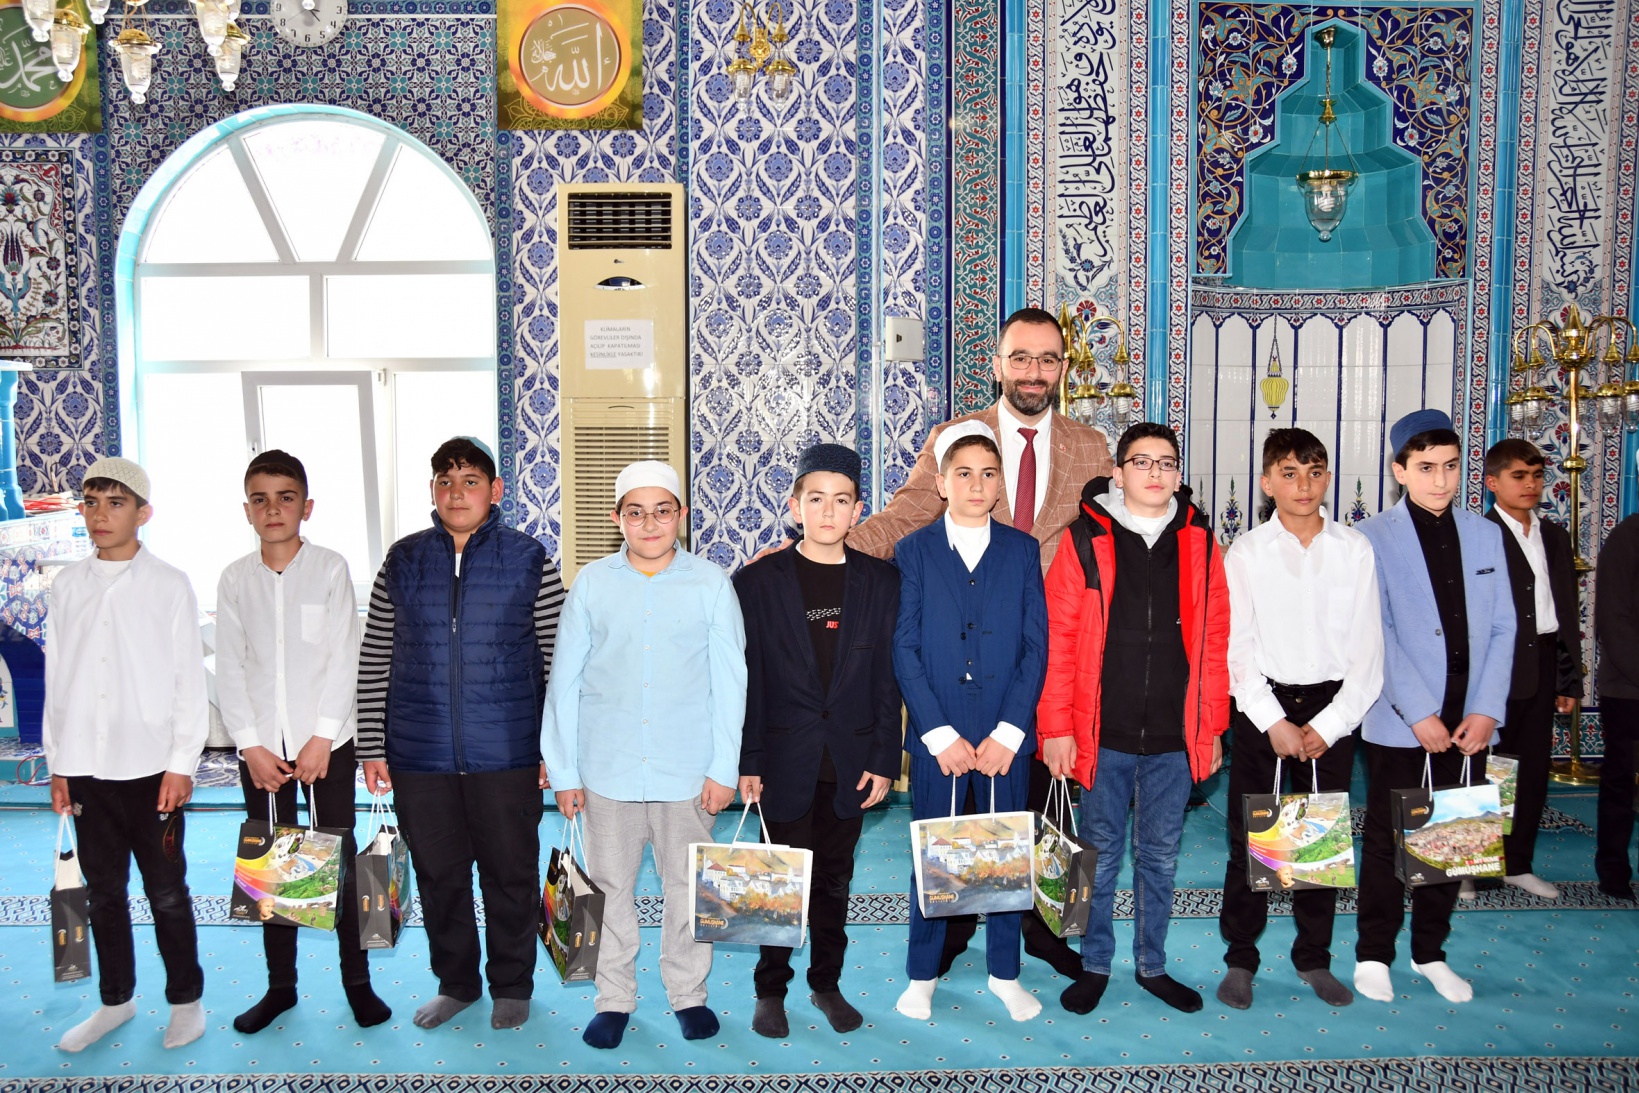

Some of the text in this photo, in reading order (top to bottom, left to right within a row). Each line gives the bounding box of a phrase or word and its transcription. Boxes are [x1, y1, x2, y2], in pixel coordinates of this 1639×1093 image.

[276, 3, 282, 12] 9
[336, 6, 342, 14] 3
[280, 18, 286, 26] 8
[330, 20, 336, 28] 4
[291, 28, 296, 38] 7
[320, 30, 326, 38] 5
[304, 34, 310, 42] 6
[542, 21, 603, 91] الله
[1445, 862, 1501, 878] GÜMÜŞHANE
